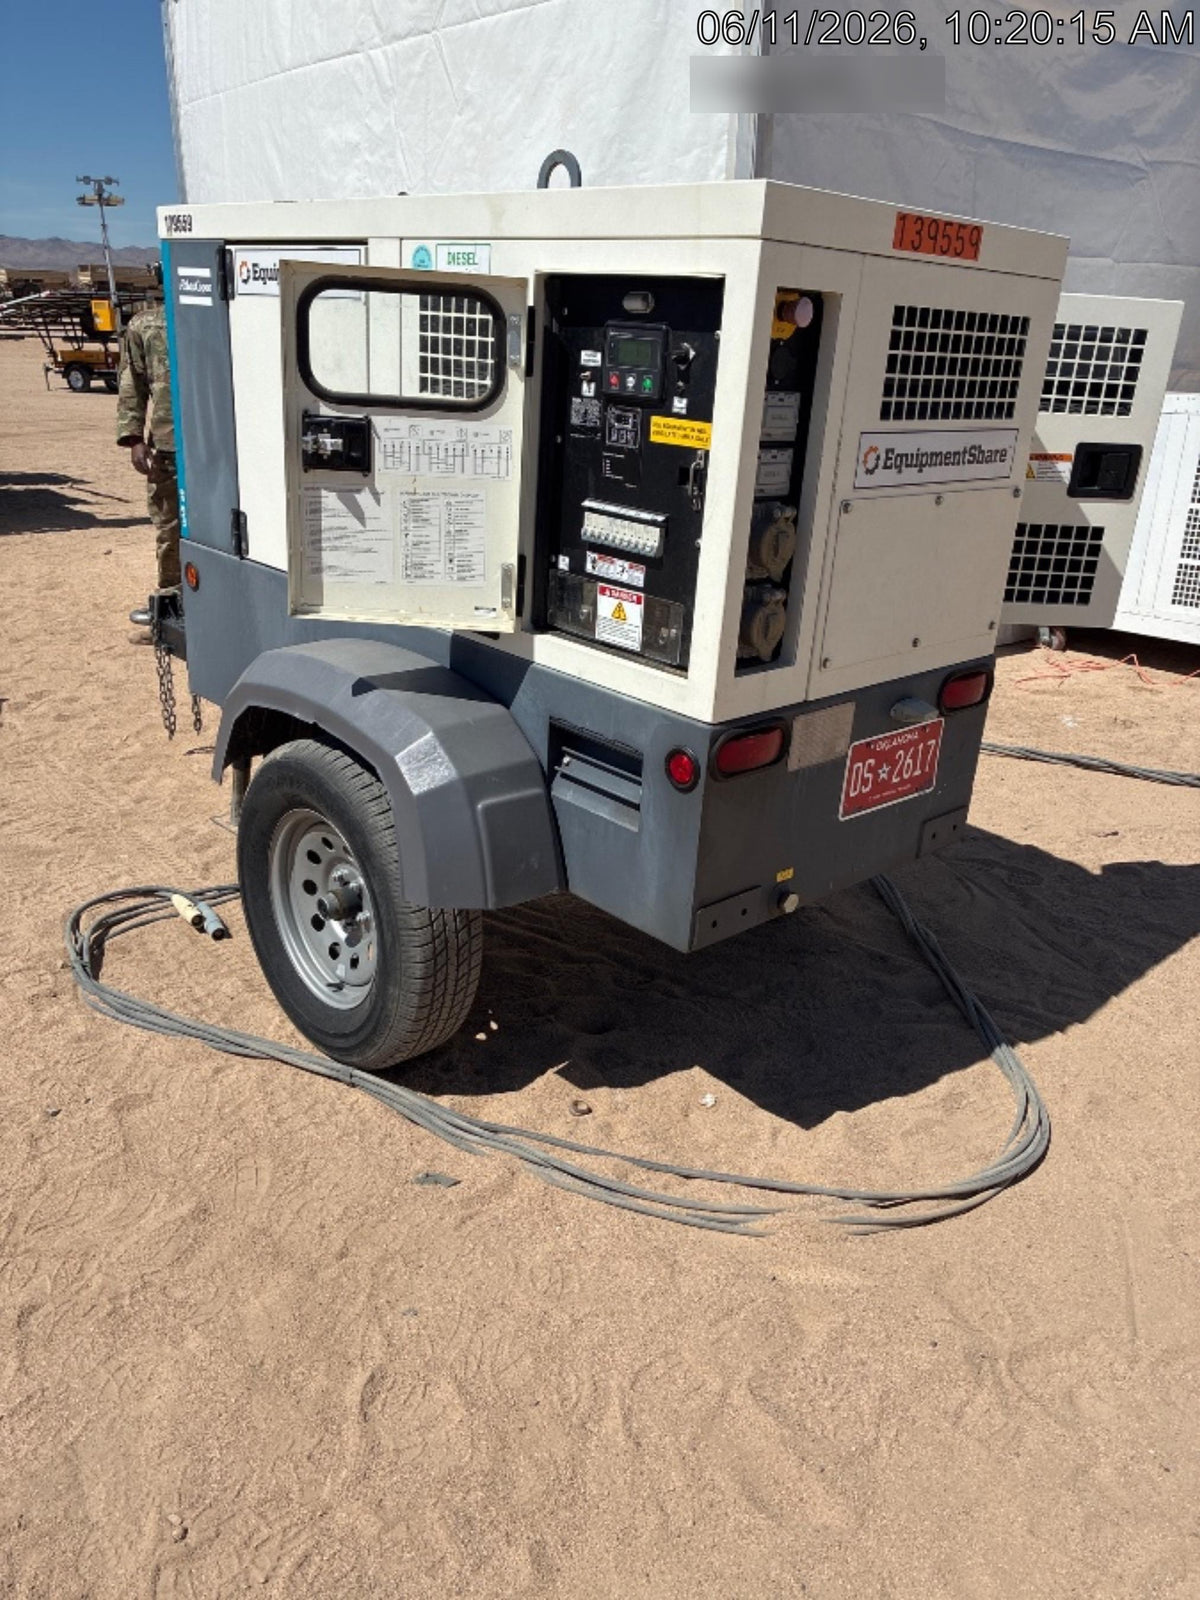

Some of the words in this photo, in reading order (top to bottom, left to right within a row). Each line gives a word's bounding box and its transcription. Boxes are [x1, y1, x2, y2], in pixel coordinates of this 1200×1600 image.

[898, 213, 981, 259] 139559
[447, 251, 479, 266] DIESEL
[882, 444, 1008, 474] EquipmentShare
[876, 731, 919, 751] OKLAHOMA
[892, 738, 936, 783] 2617
